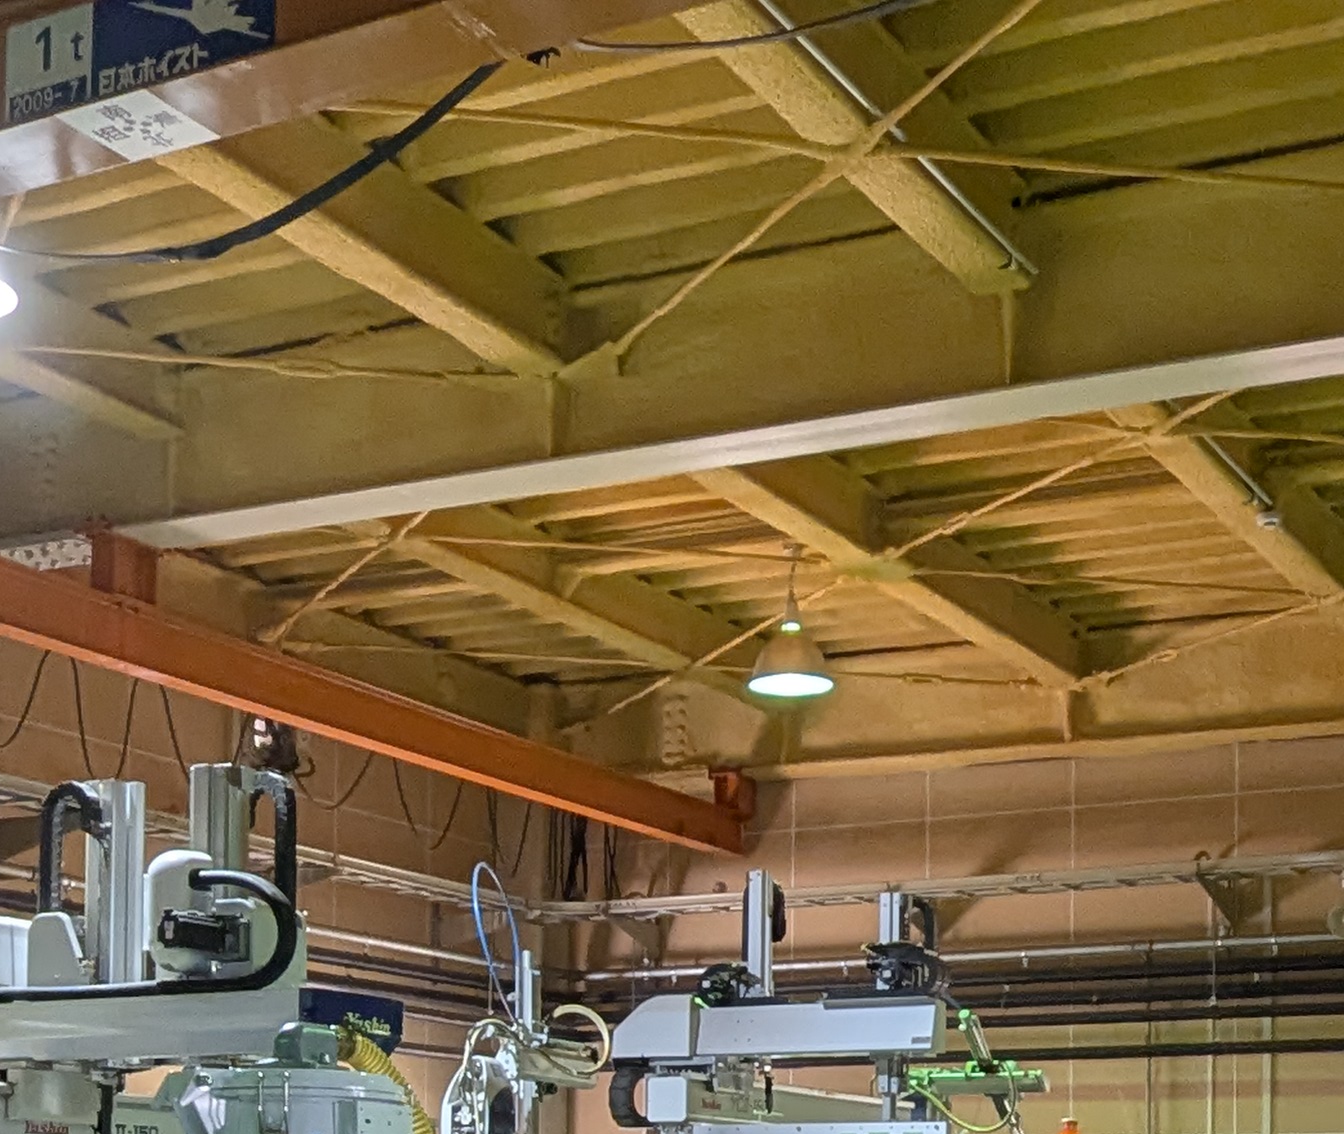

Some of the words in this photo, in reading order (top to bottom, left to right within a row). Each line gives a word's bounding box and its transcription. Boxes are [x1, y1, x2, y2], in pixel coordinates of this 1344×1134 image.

[98, 42, 209, 96] 日本ホイスト
